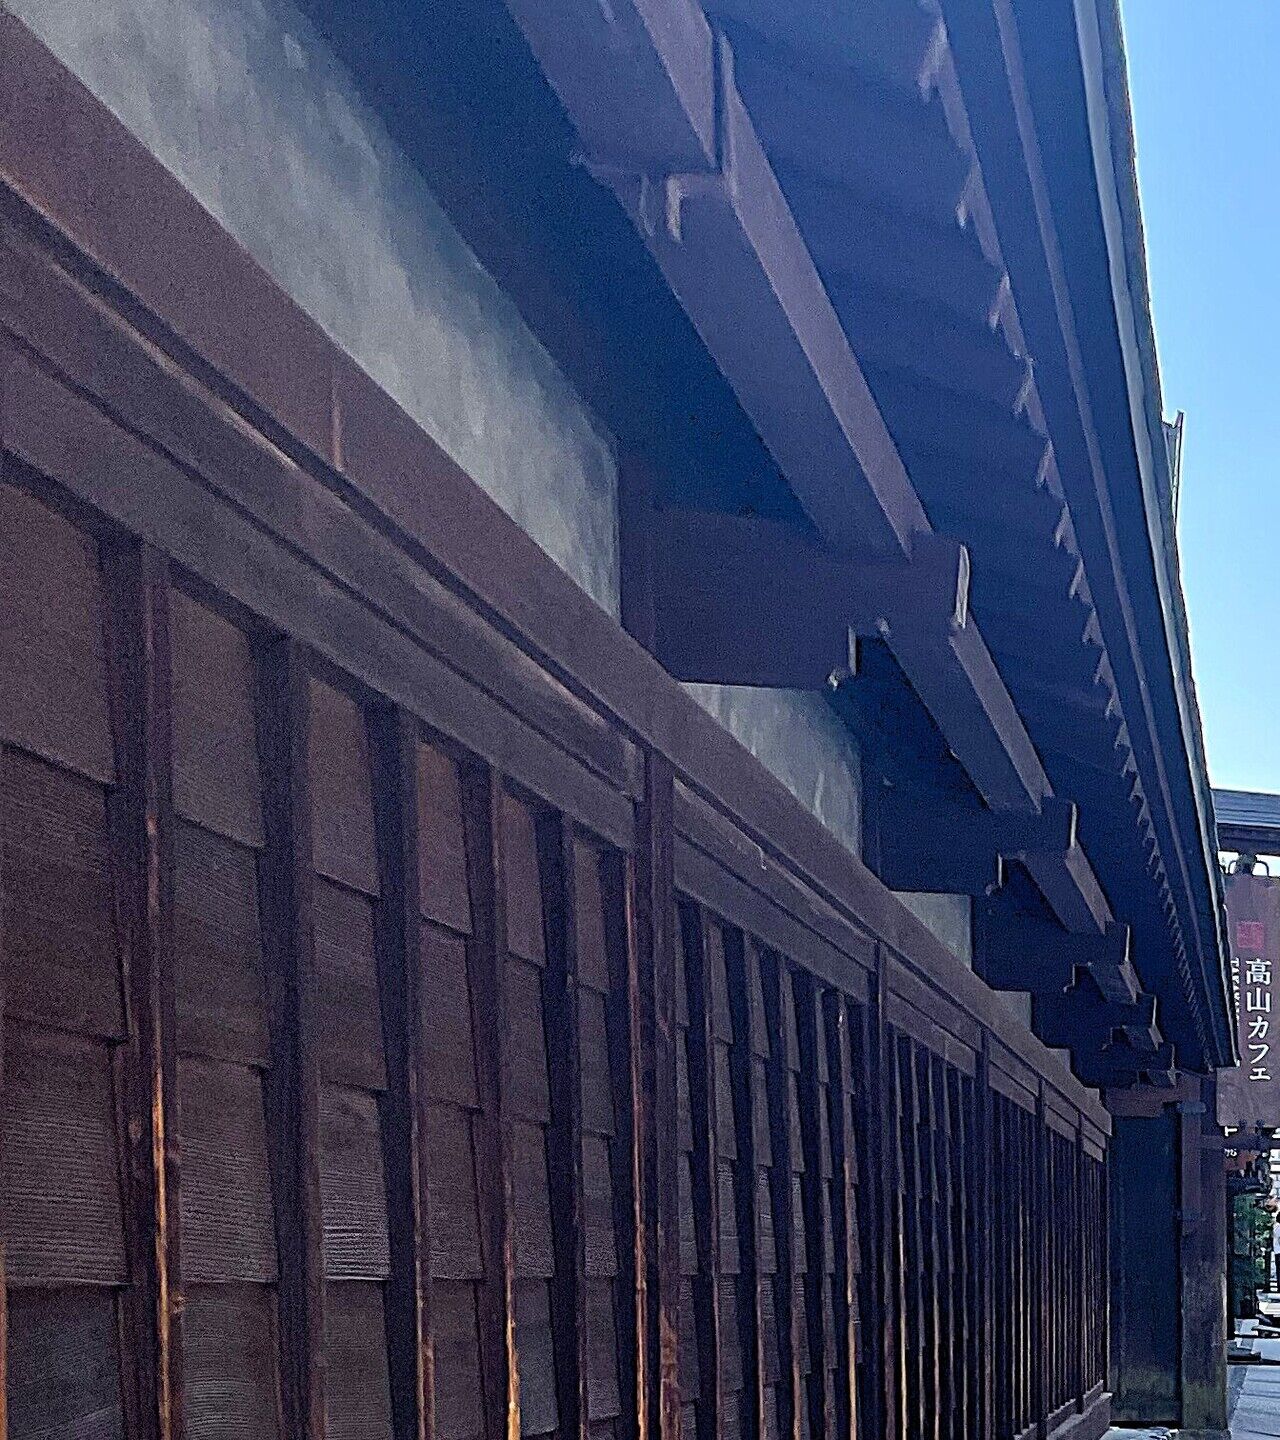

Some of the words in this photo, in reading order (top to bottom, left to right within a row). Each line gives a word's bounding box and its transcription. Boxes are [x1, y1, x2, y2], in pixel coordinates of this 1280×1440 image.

[1245, 958, 1272, 1080] 高山カフェ
